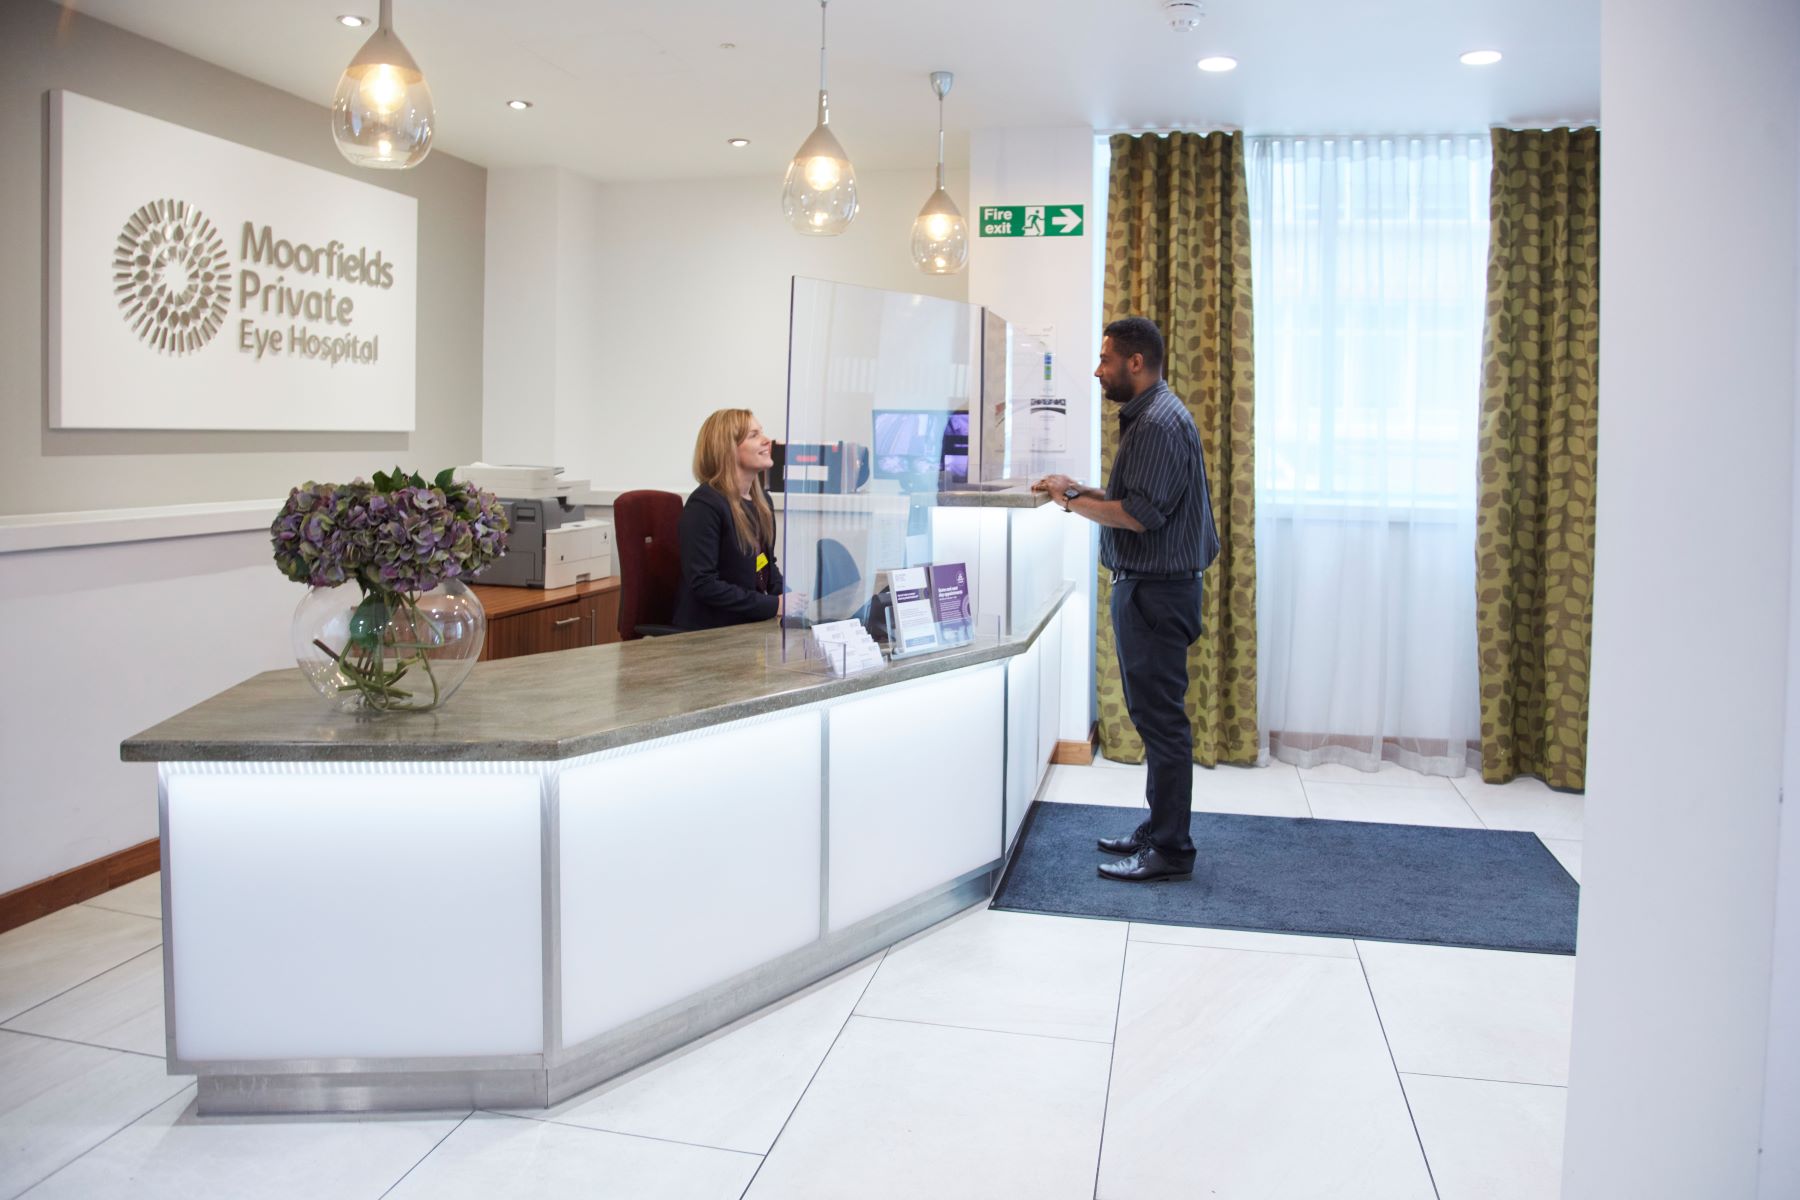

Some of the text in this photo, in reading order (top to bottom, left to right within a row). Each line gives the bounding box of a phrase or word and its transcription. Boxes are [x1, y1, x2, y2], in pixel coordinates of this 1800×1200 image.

[984, 208, 1013, 221] Fire
[984, 222, 1012, 234] exit
[240, 221, 394, 290] Moorfields
[239, 269, 354, 326] Private
[239, 319, 379, 367] Eye Hospital
